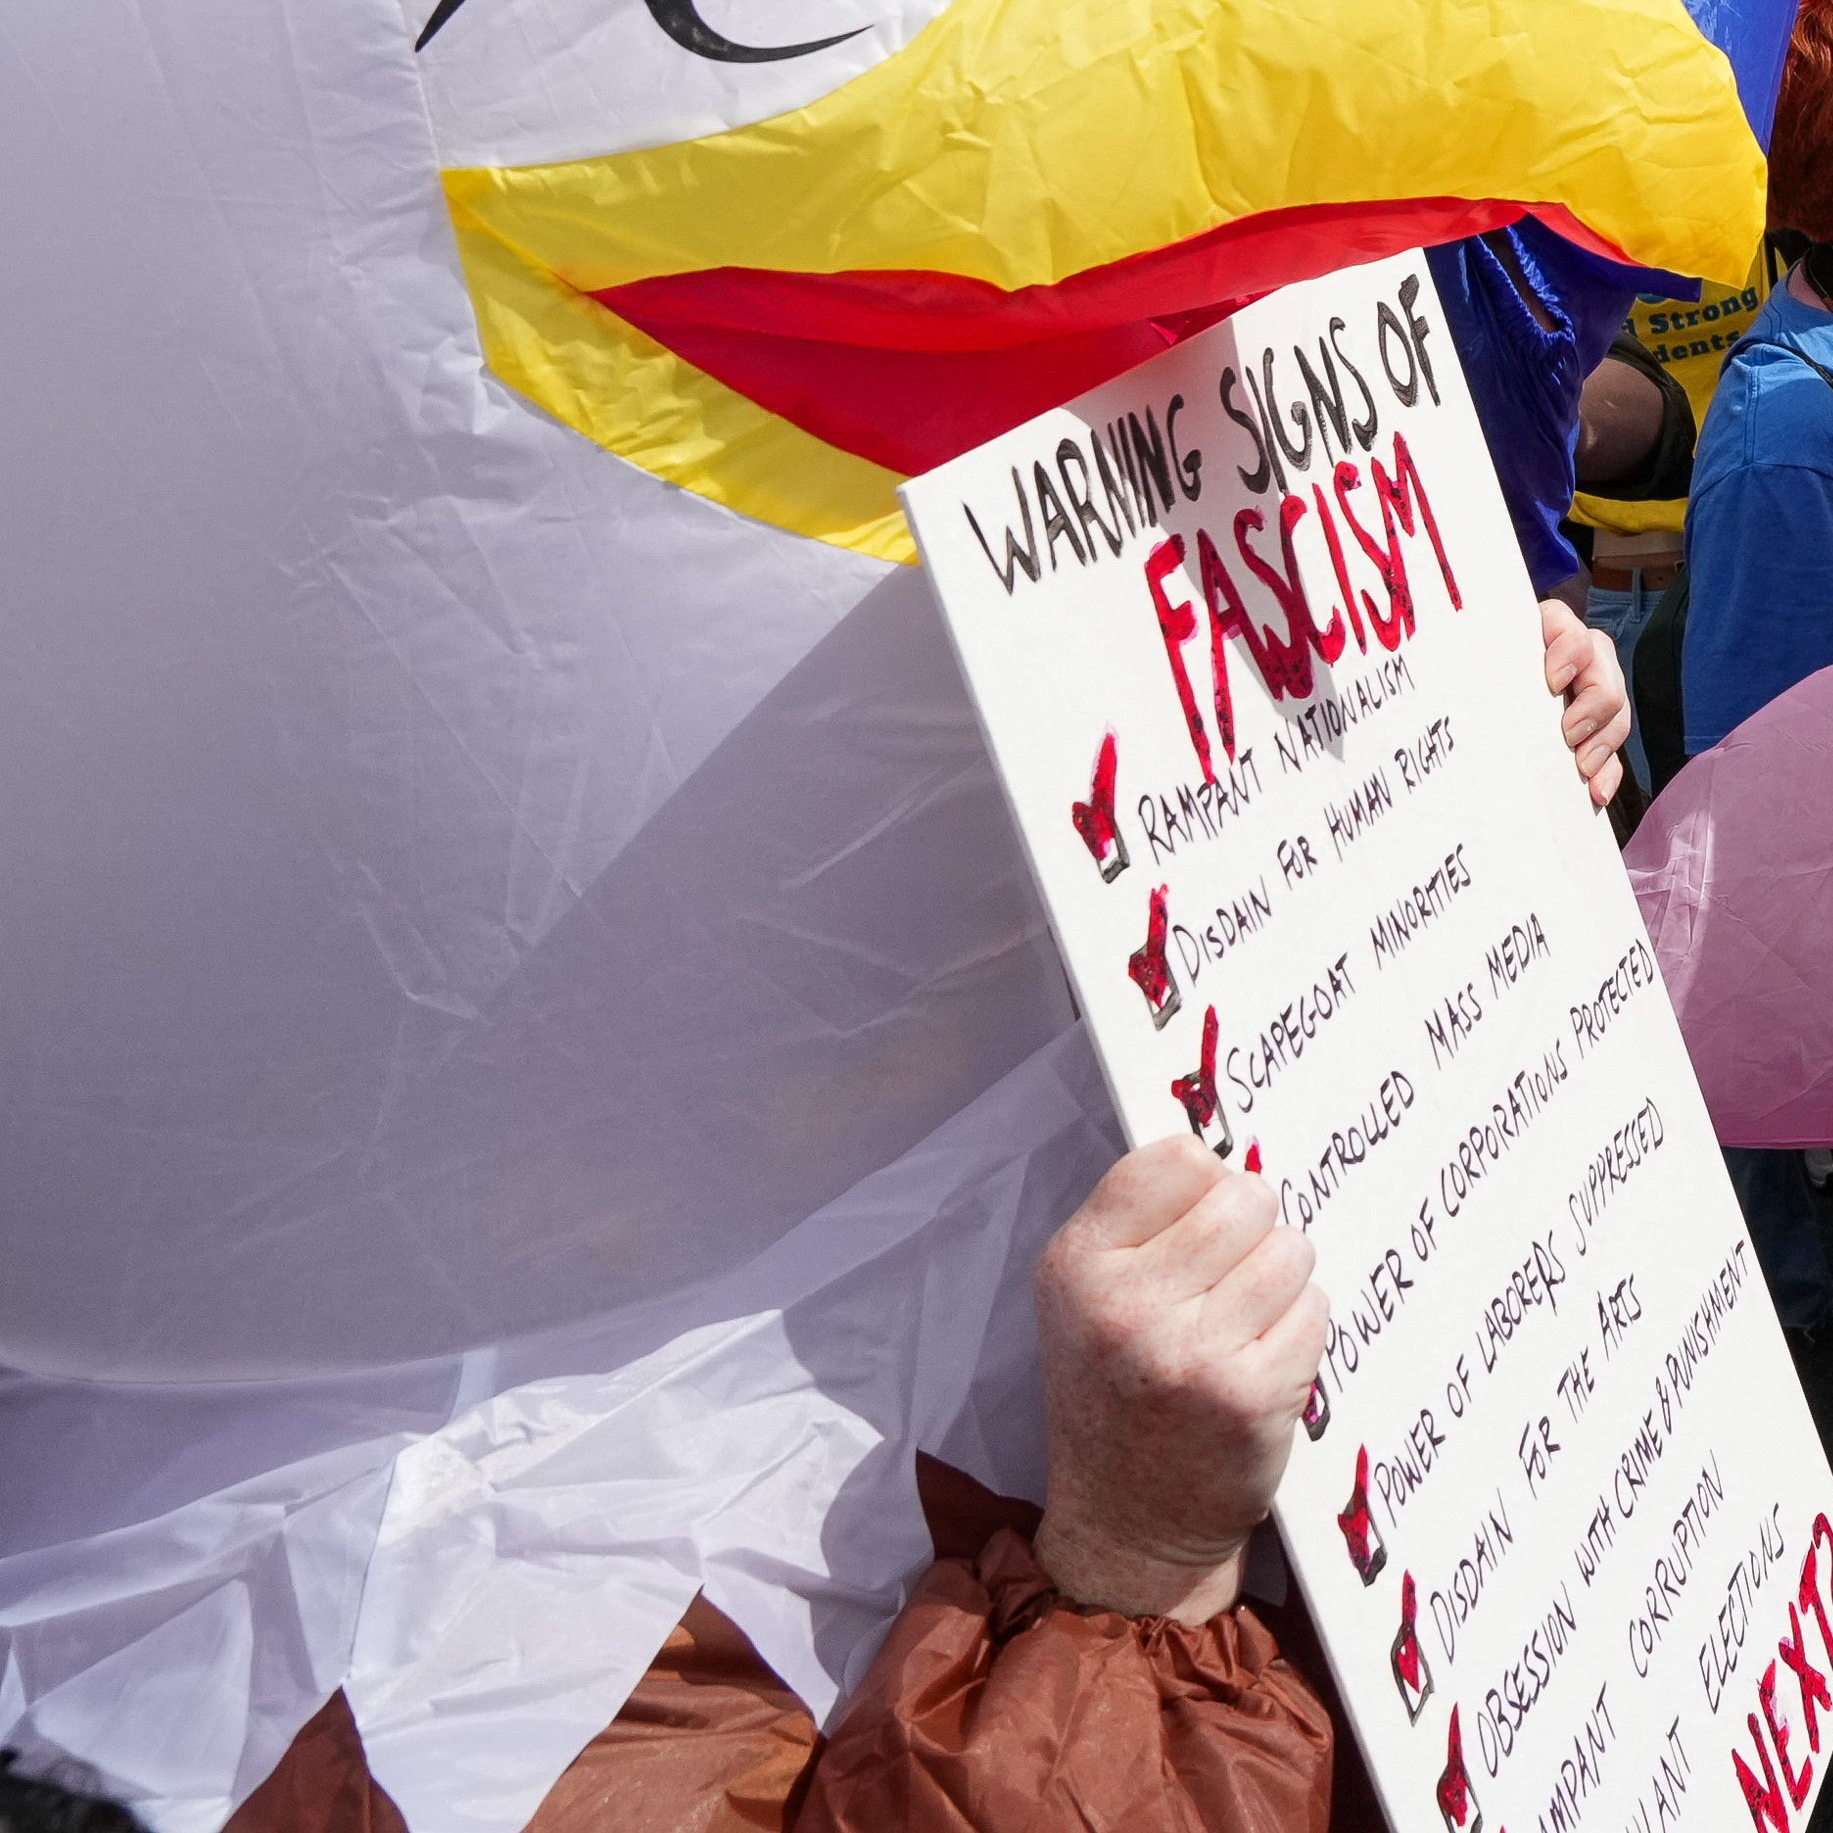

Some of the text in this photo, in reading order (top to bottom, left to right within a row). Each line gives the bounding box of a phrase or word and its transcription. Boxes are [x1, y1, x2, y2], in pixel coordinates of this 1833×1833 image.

[962, 272, 1441, 596] WARNING SIGNS OF
[1649, 285, 1759, 336] Strong
[1654, 332, 1739, 365] dents
[1138, 655, 1415, 867] RAMPANT NATIONALISM
[1144, 430, 1464, 784] FASCISM
[1277, 835, 1318, 890] FOR
[1322, 767, 1393, 862] HUMAN
[1395, 714, 1455, 793] RIGHTS
[1370, 842, 1473, 970] MINORITIES
[1280, 910, 1551, 1234] CONTROLLED MASS MEDIA
[1319, 938, 1655, 1393] POWER OF CORPORATIONS PROTECTED
[1373, 1095, 1666, 1528] POWER OF LABORERS SUPPRESSED
[1429, 1273, 1644, 1666] DISDAIN FOR THE ARTS
[1476, 1580, 1579, 1779] OBSESSION
[1574, 1494, 1616, 1588] WITH
[1611, 1409, 1664, 1520] CRIME
[1666, 1239, 1753, 1410] PUNISHMENT
[1537, 1679, 1618, 1833] AMPANT
[1628, 1447, 1725, 1679] CORRUPTION
[1699, 1503, 1789, 1715] ELECTIONS
